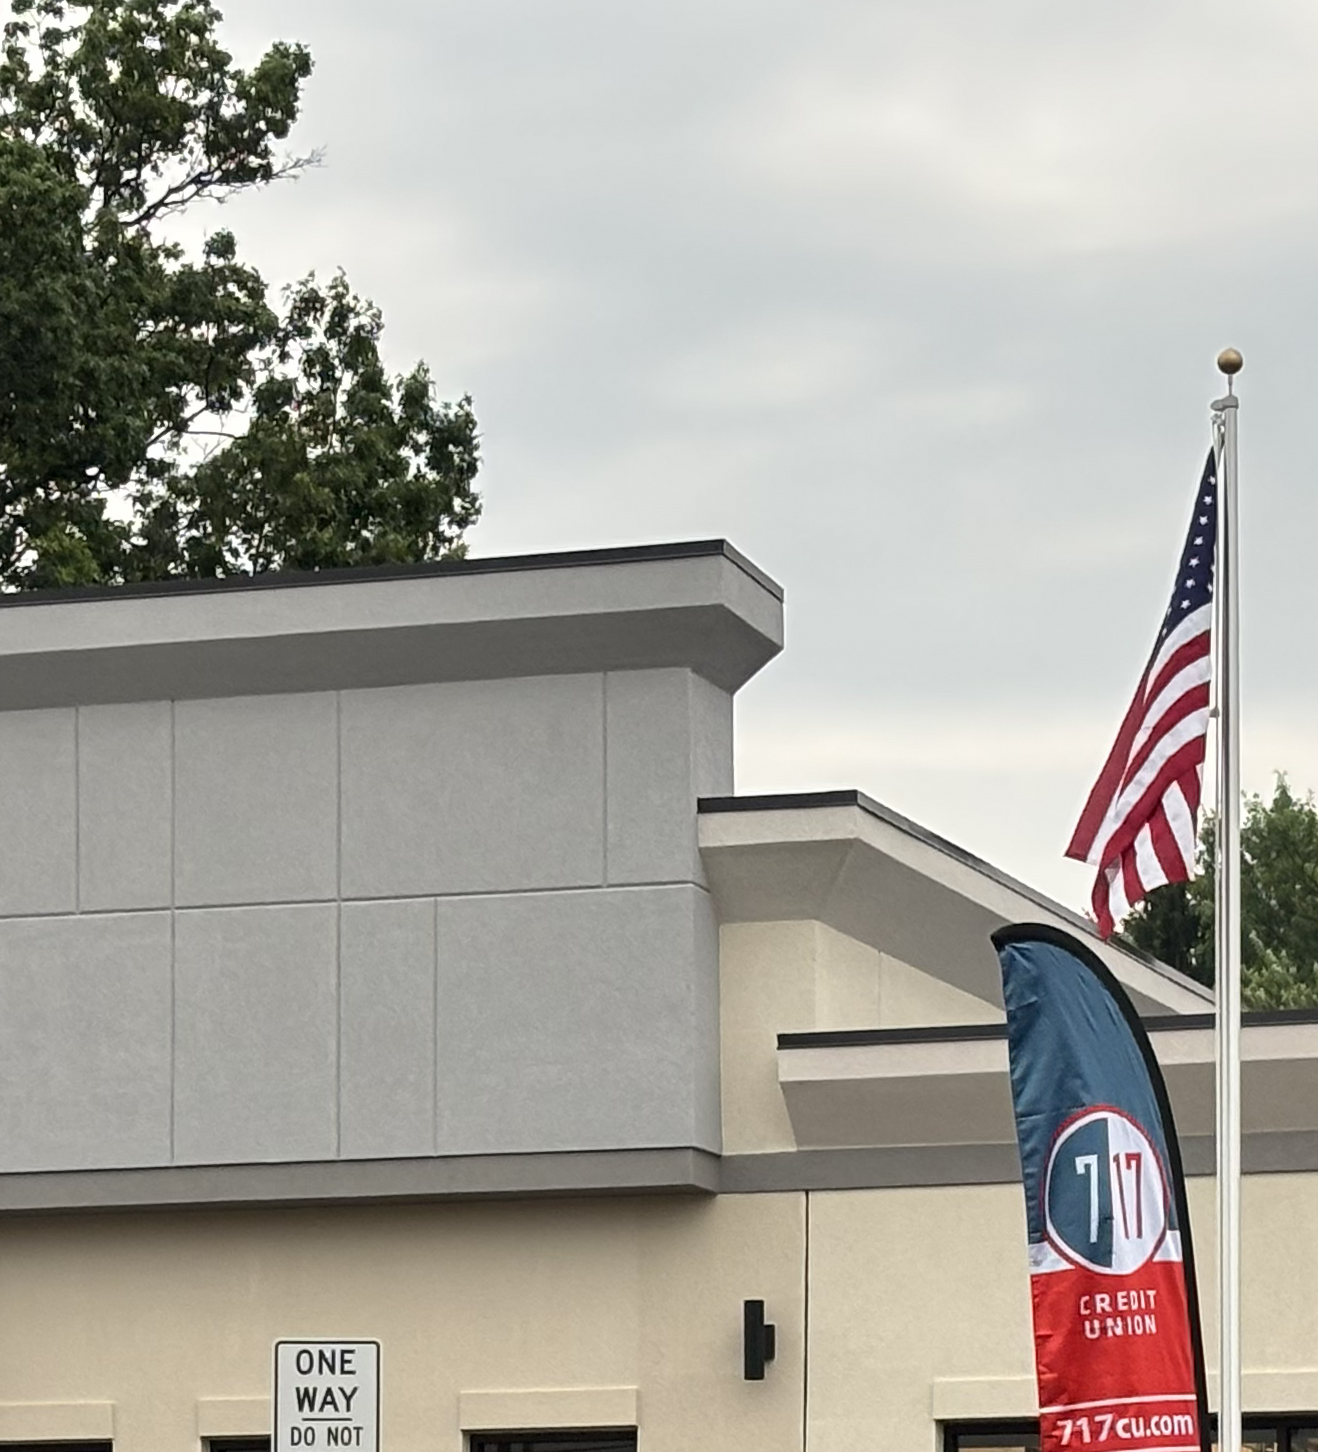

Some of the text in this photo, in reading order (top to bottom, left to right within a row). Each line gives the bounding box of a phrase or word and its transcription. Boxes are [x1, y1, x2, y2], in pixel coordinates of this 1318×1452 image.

[1080, 1290, 1157, 1315] CREDIT
[1084, 1314, 1157, 1339] UNION
[295, 1349, 357, 1376] ONE
[295, 1386, 359, 1413] WAY
[290, 1426, 364, 1447] DO NOT
[1056, 1413, 1194, 1446] 717cu.com
